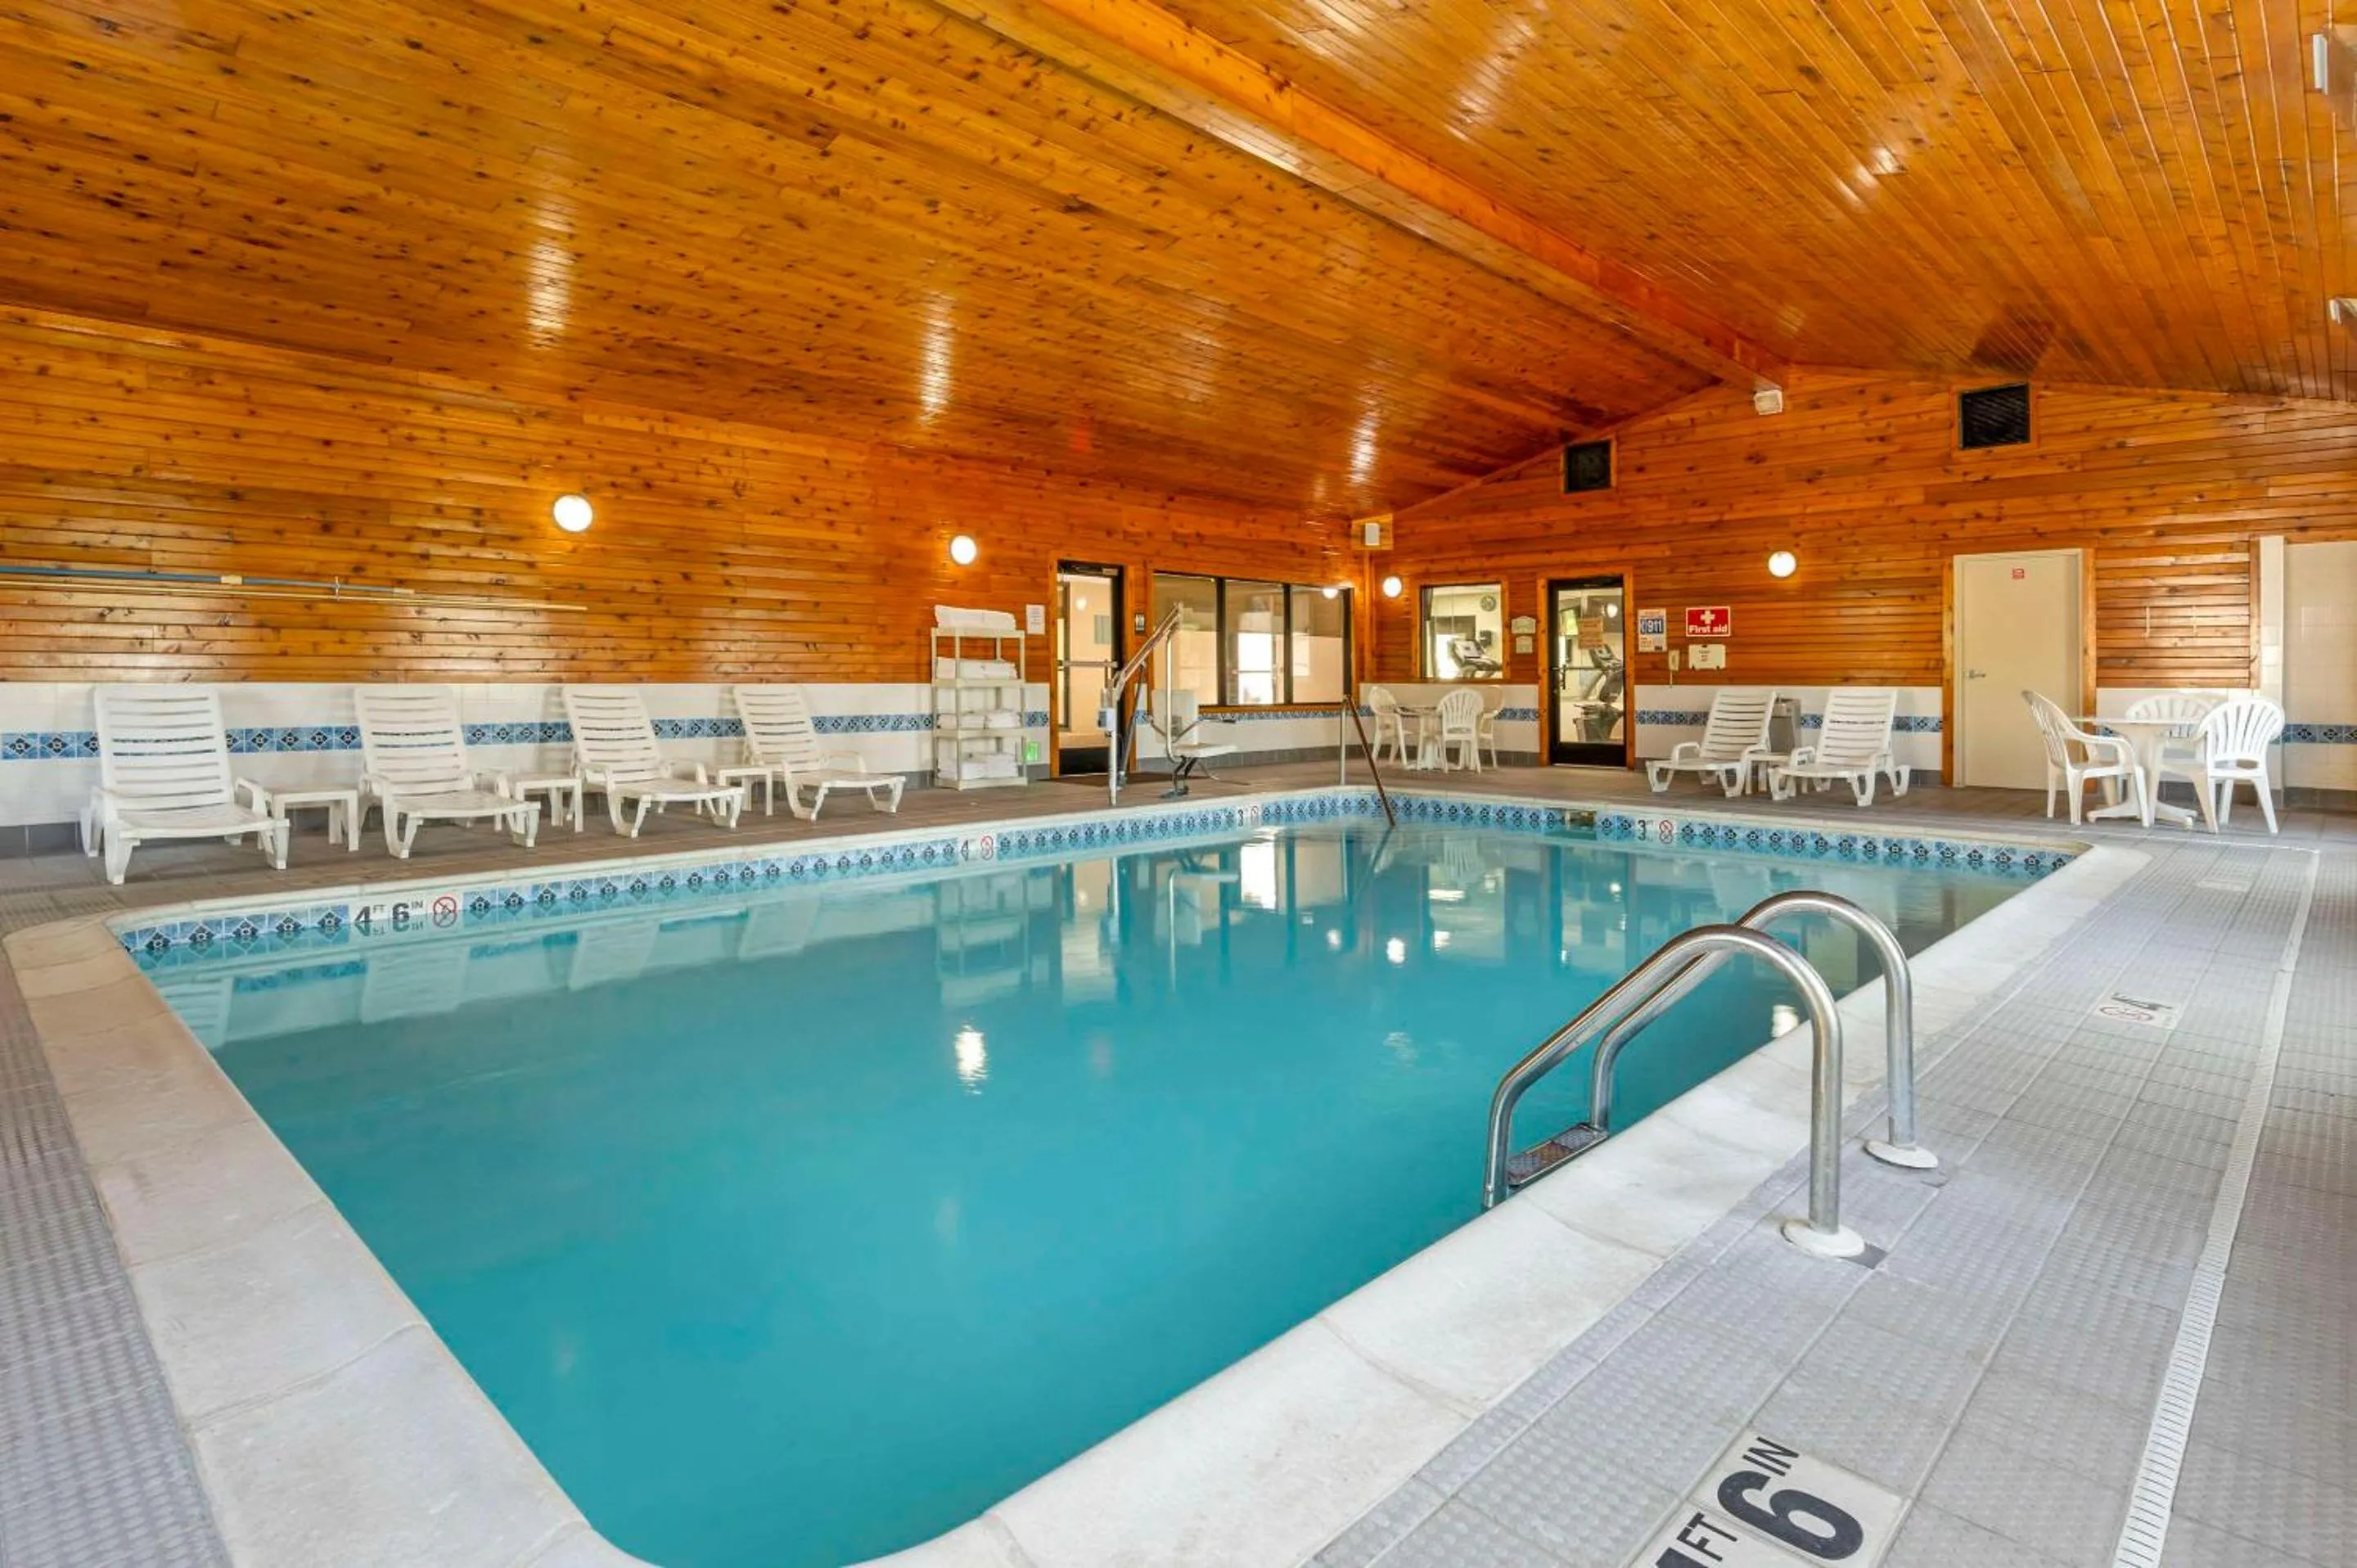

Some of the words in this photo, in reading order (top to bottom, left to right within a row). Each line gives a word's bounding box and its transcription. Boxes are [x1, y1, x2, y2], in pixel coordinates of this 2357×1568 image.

[1647, 620, 1662, 633] 911
[1688, 624, 1710, 633] First
[1712, 623, 1728, 633] aid
[354, 906, 372, 923] 4
[373, 904, 385, 913] FT
[392, 903, 410, 923] 6
[412, 900, 423, 910] IN
[1742, 1436, 1800, 1477] IN
[1716, 1470, 1864, 1561] 6
[1676, 1512, 1737, 1561] FT
